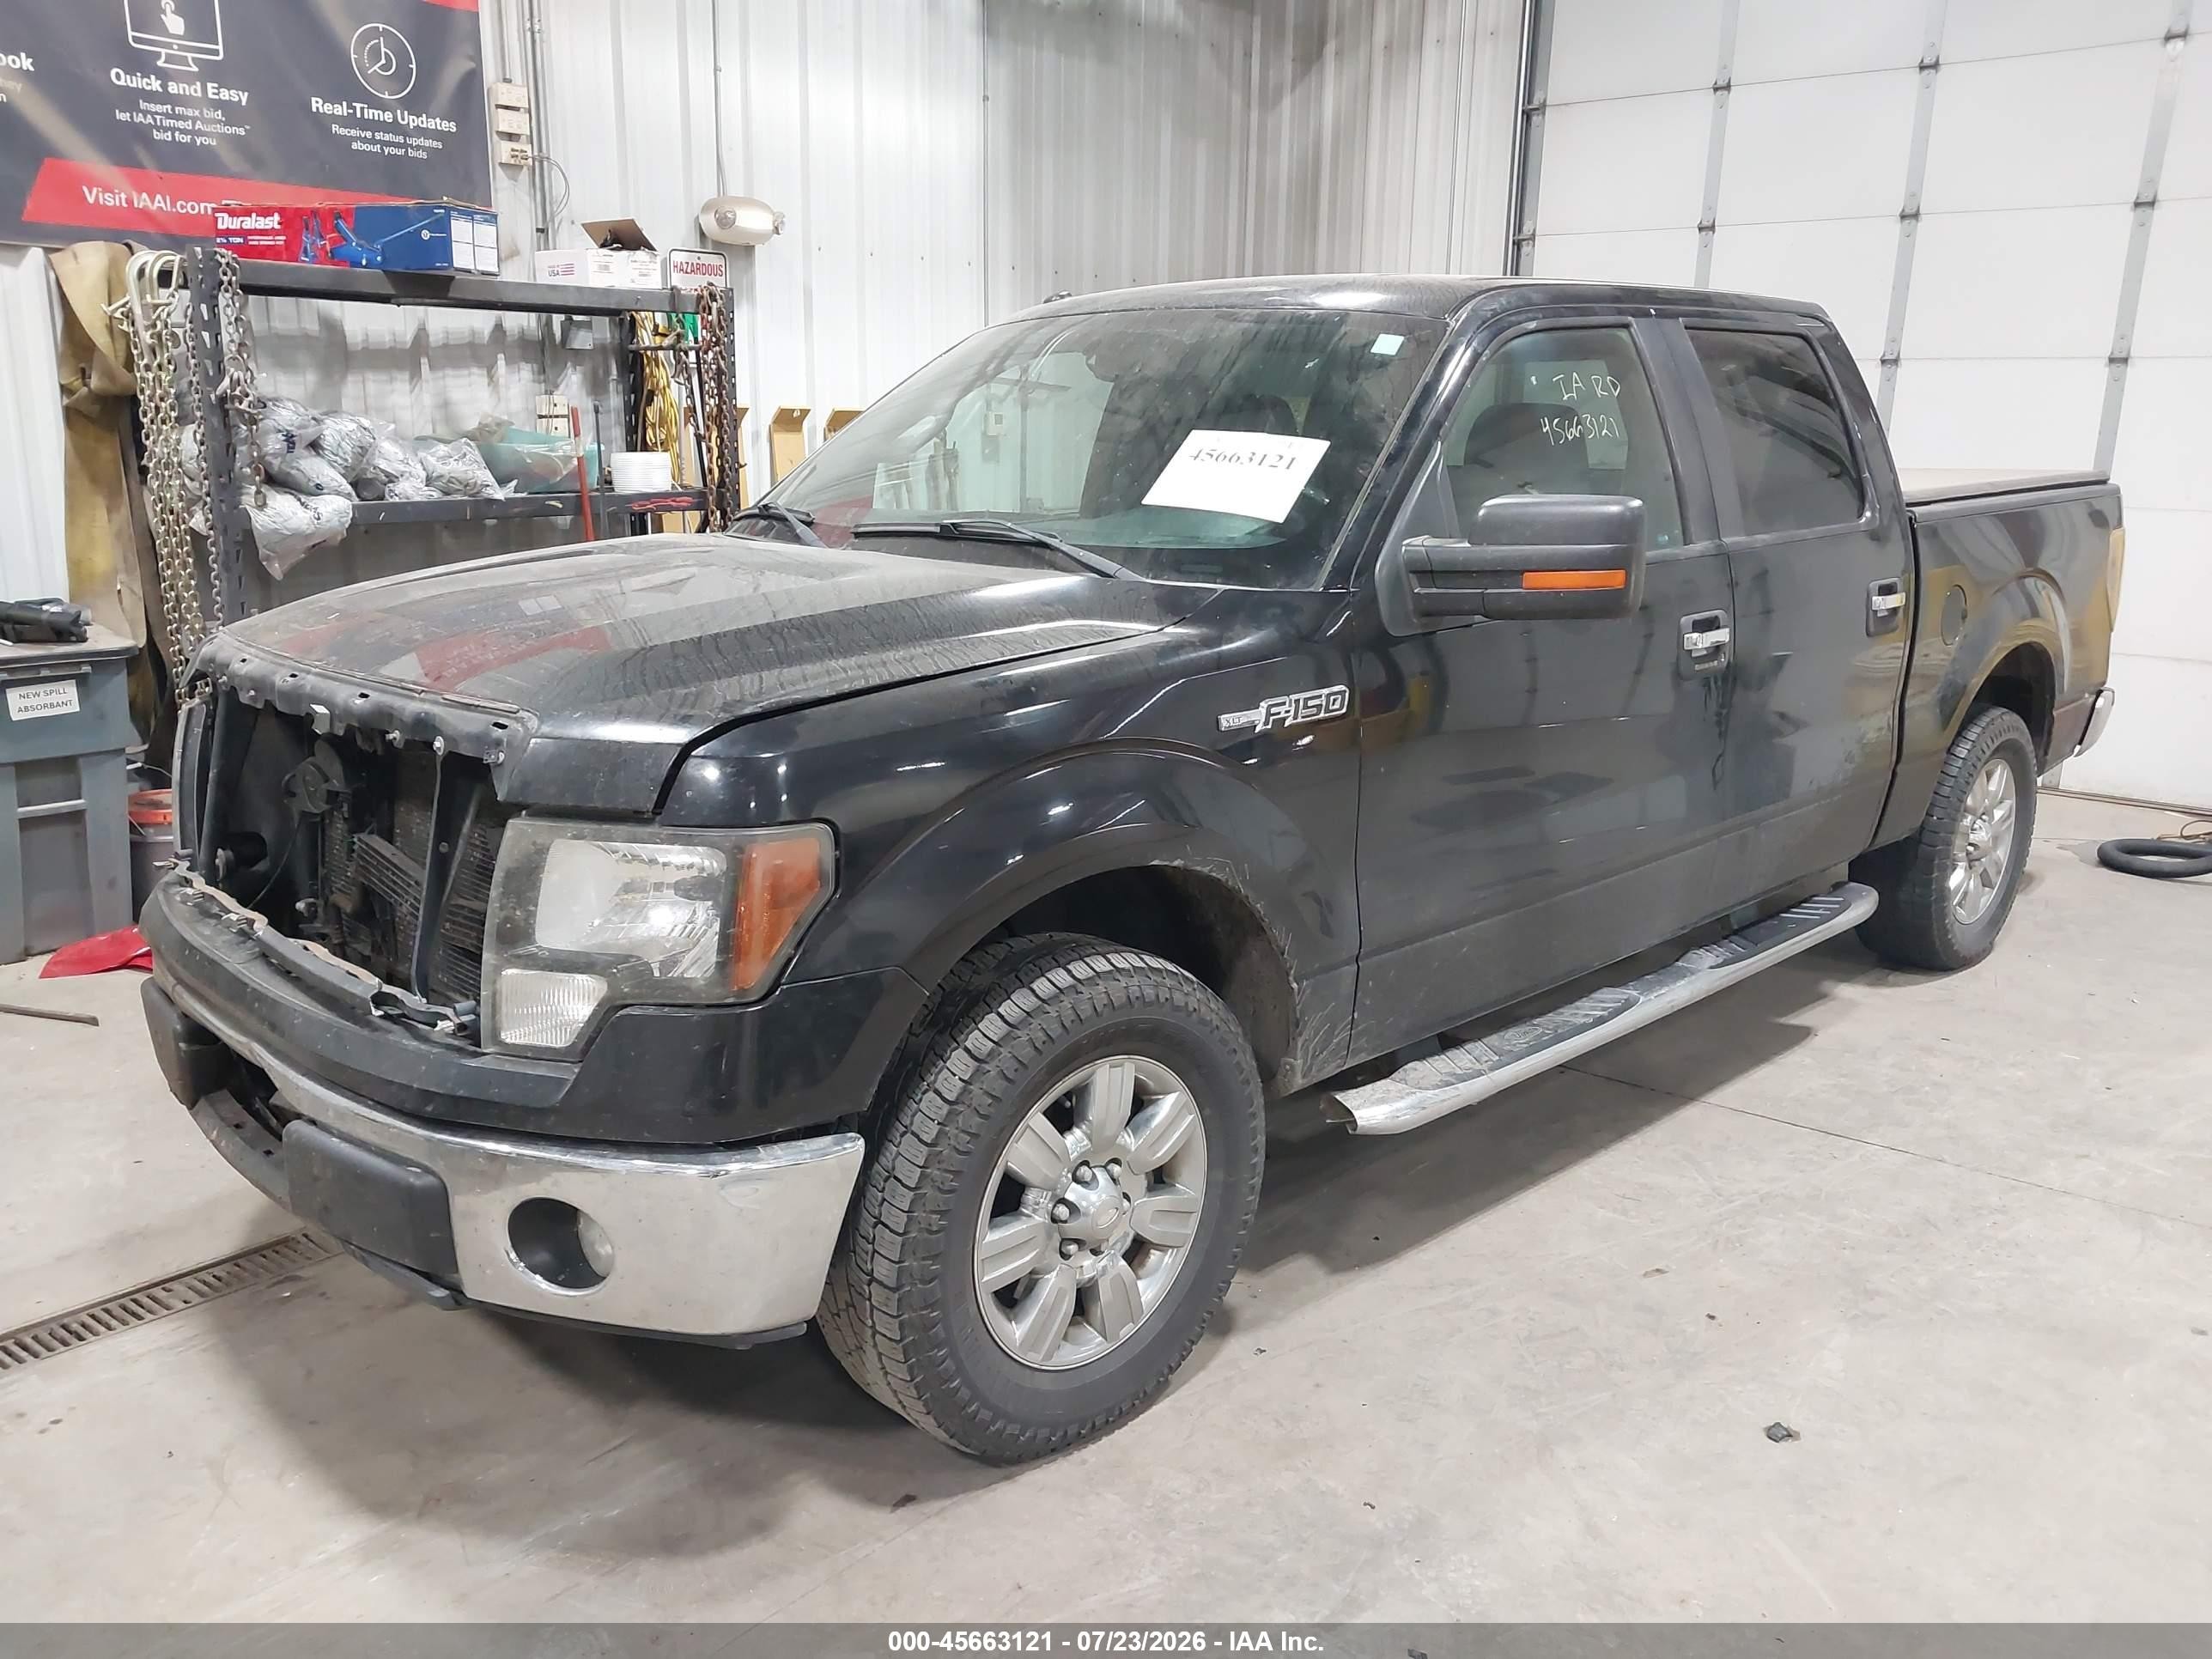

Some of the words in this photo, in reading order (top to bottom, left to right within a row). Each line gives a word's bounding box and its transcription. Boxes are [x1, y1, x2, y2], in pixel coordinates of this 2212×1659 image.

[110, 68, 163, 92] Quick
[167, 82, 202, 97] and
[207, 82, 249, 106] Easy
[115, 109, 131, 122] let
[139, 100, 173, 113] Insert
[175, 105, 200, 118] max
[311, 97, 393, 123] Real-Time
[397, 109, 457, 132] Updates
[153, 130, 171, 141] bid
[174, 131, 191, 143] for
[194, 135, 216, 146] you
[331, 124, 372, 139] Receive
[374, 132, 404, 143] status
[406, 136, 443, 149] updates
[351, 141, 381, 153] about
[383, 145, 406, 156] your
[408, 148, 428, 160] bids
[82, 185, 128, 208] Visit
[215, 212, 282, 230] Duralast
[548, 269, 560, 277] USA
[672, 261, 724, 277] HAZARDOUS
[1540, 413, 1620, 447] 45663121
[1188, 448, 1297, 471] 45663121
[19, 690, 41, 700] NEW
[43, 688, 68, 696] SPILL
[17, 700, 73, 714] ABSORBANT
[1225, 716, 1243, 726] XLT
